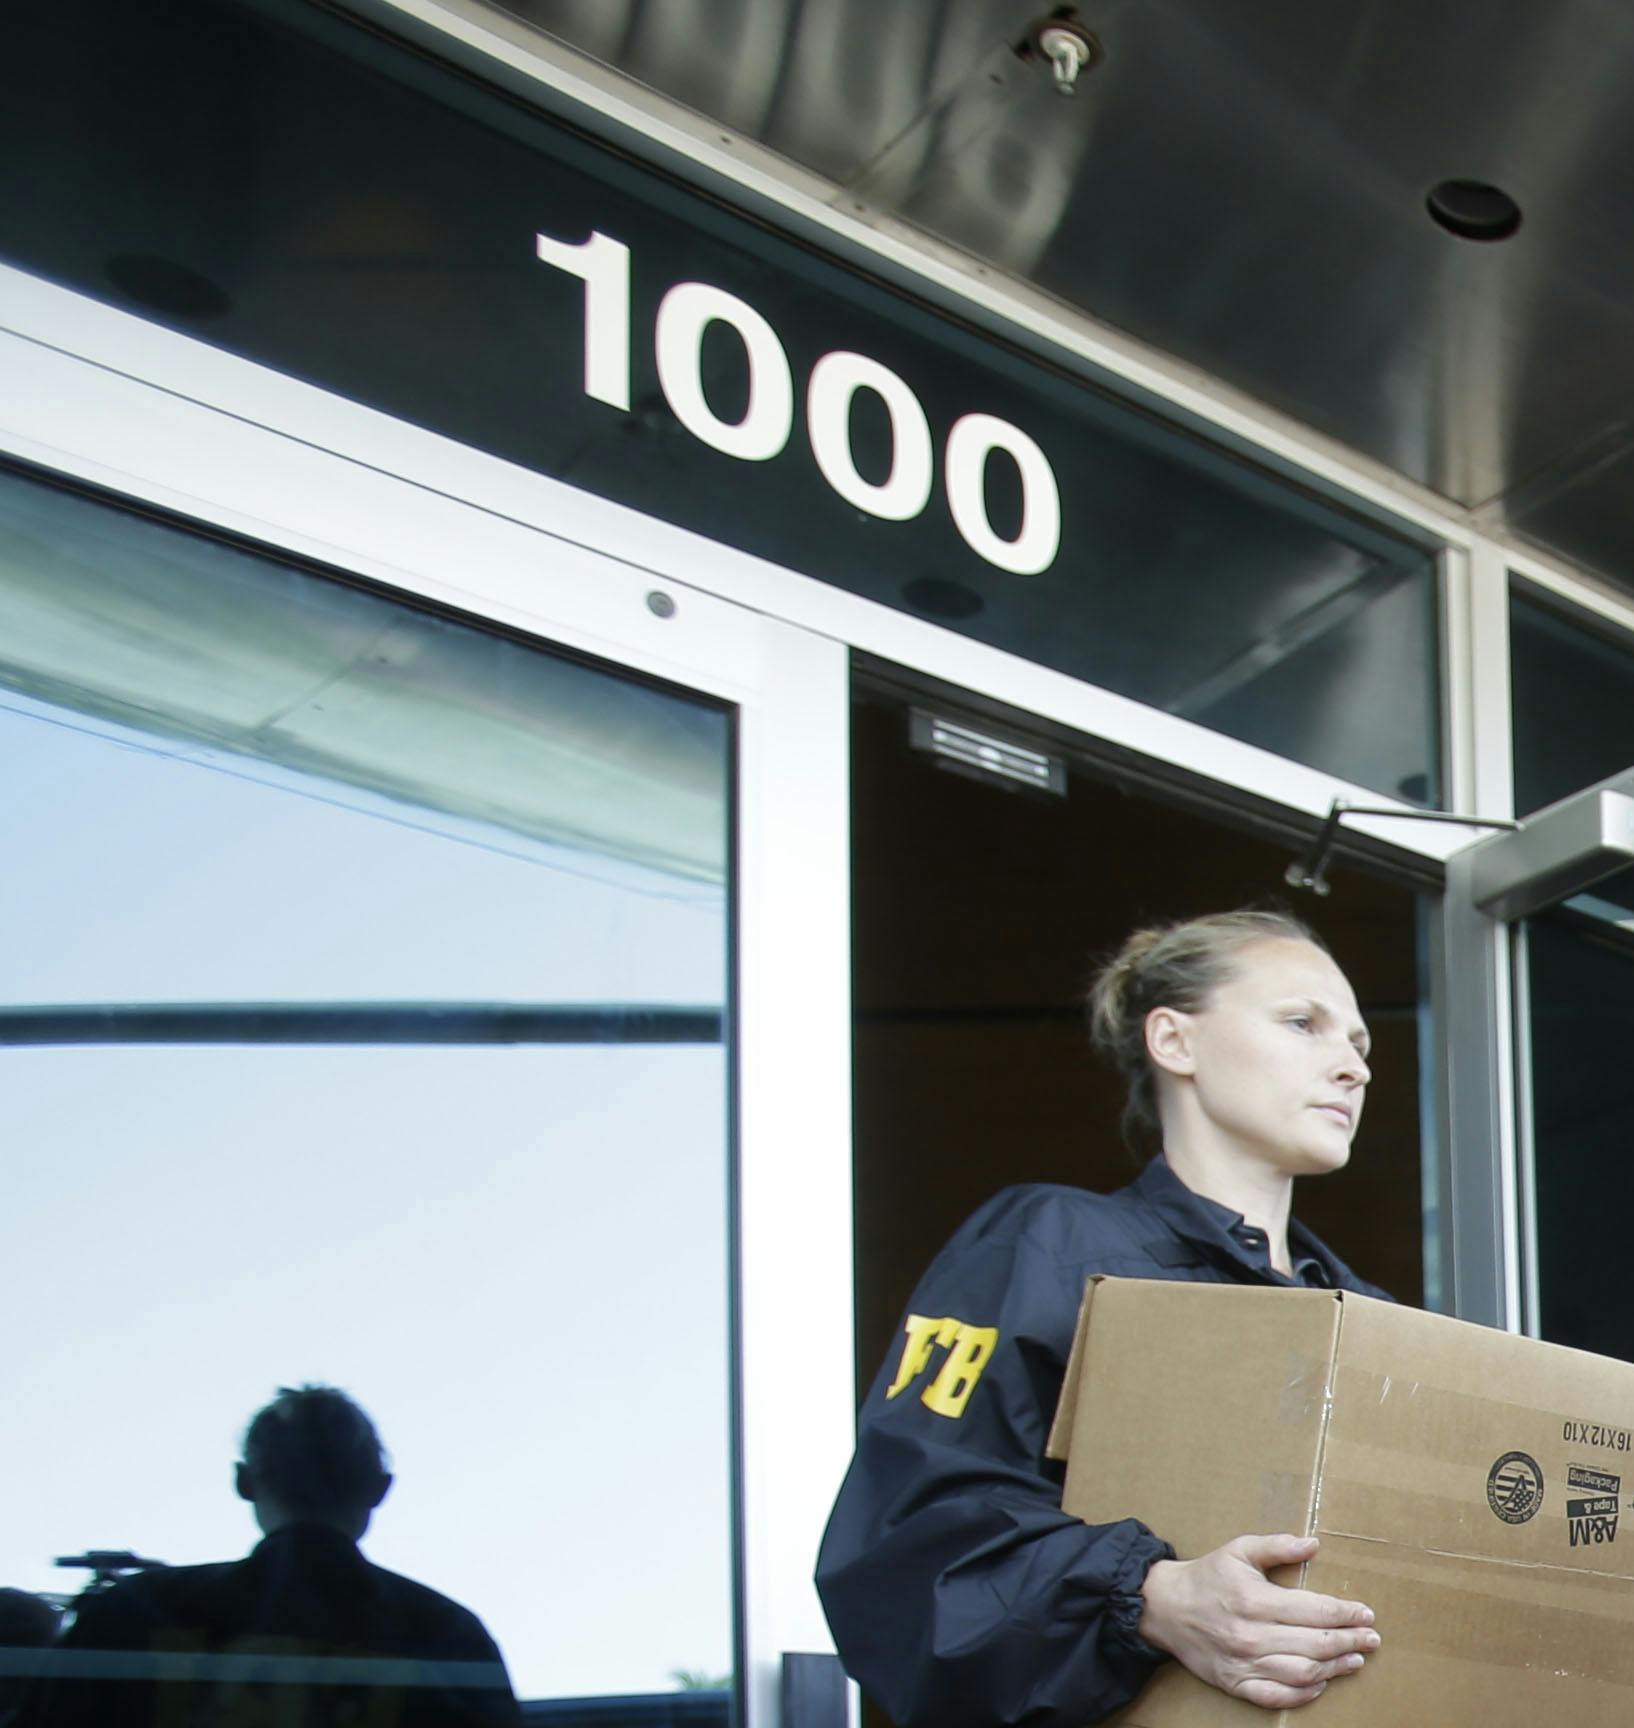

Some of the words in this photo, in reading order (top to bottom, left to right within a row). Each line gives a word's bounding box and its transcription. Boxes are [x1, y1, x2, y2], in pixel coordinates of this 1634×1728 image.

[535, 229, 1061, 576] 1000
[1569, 1469, 1618, 1492] Packaging
[1583, 1503, 1592, 1514] &
[1593, 1500, 1617, 1513] Tape
[1569, 1515, 1619, 1547] A&M
